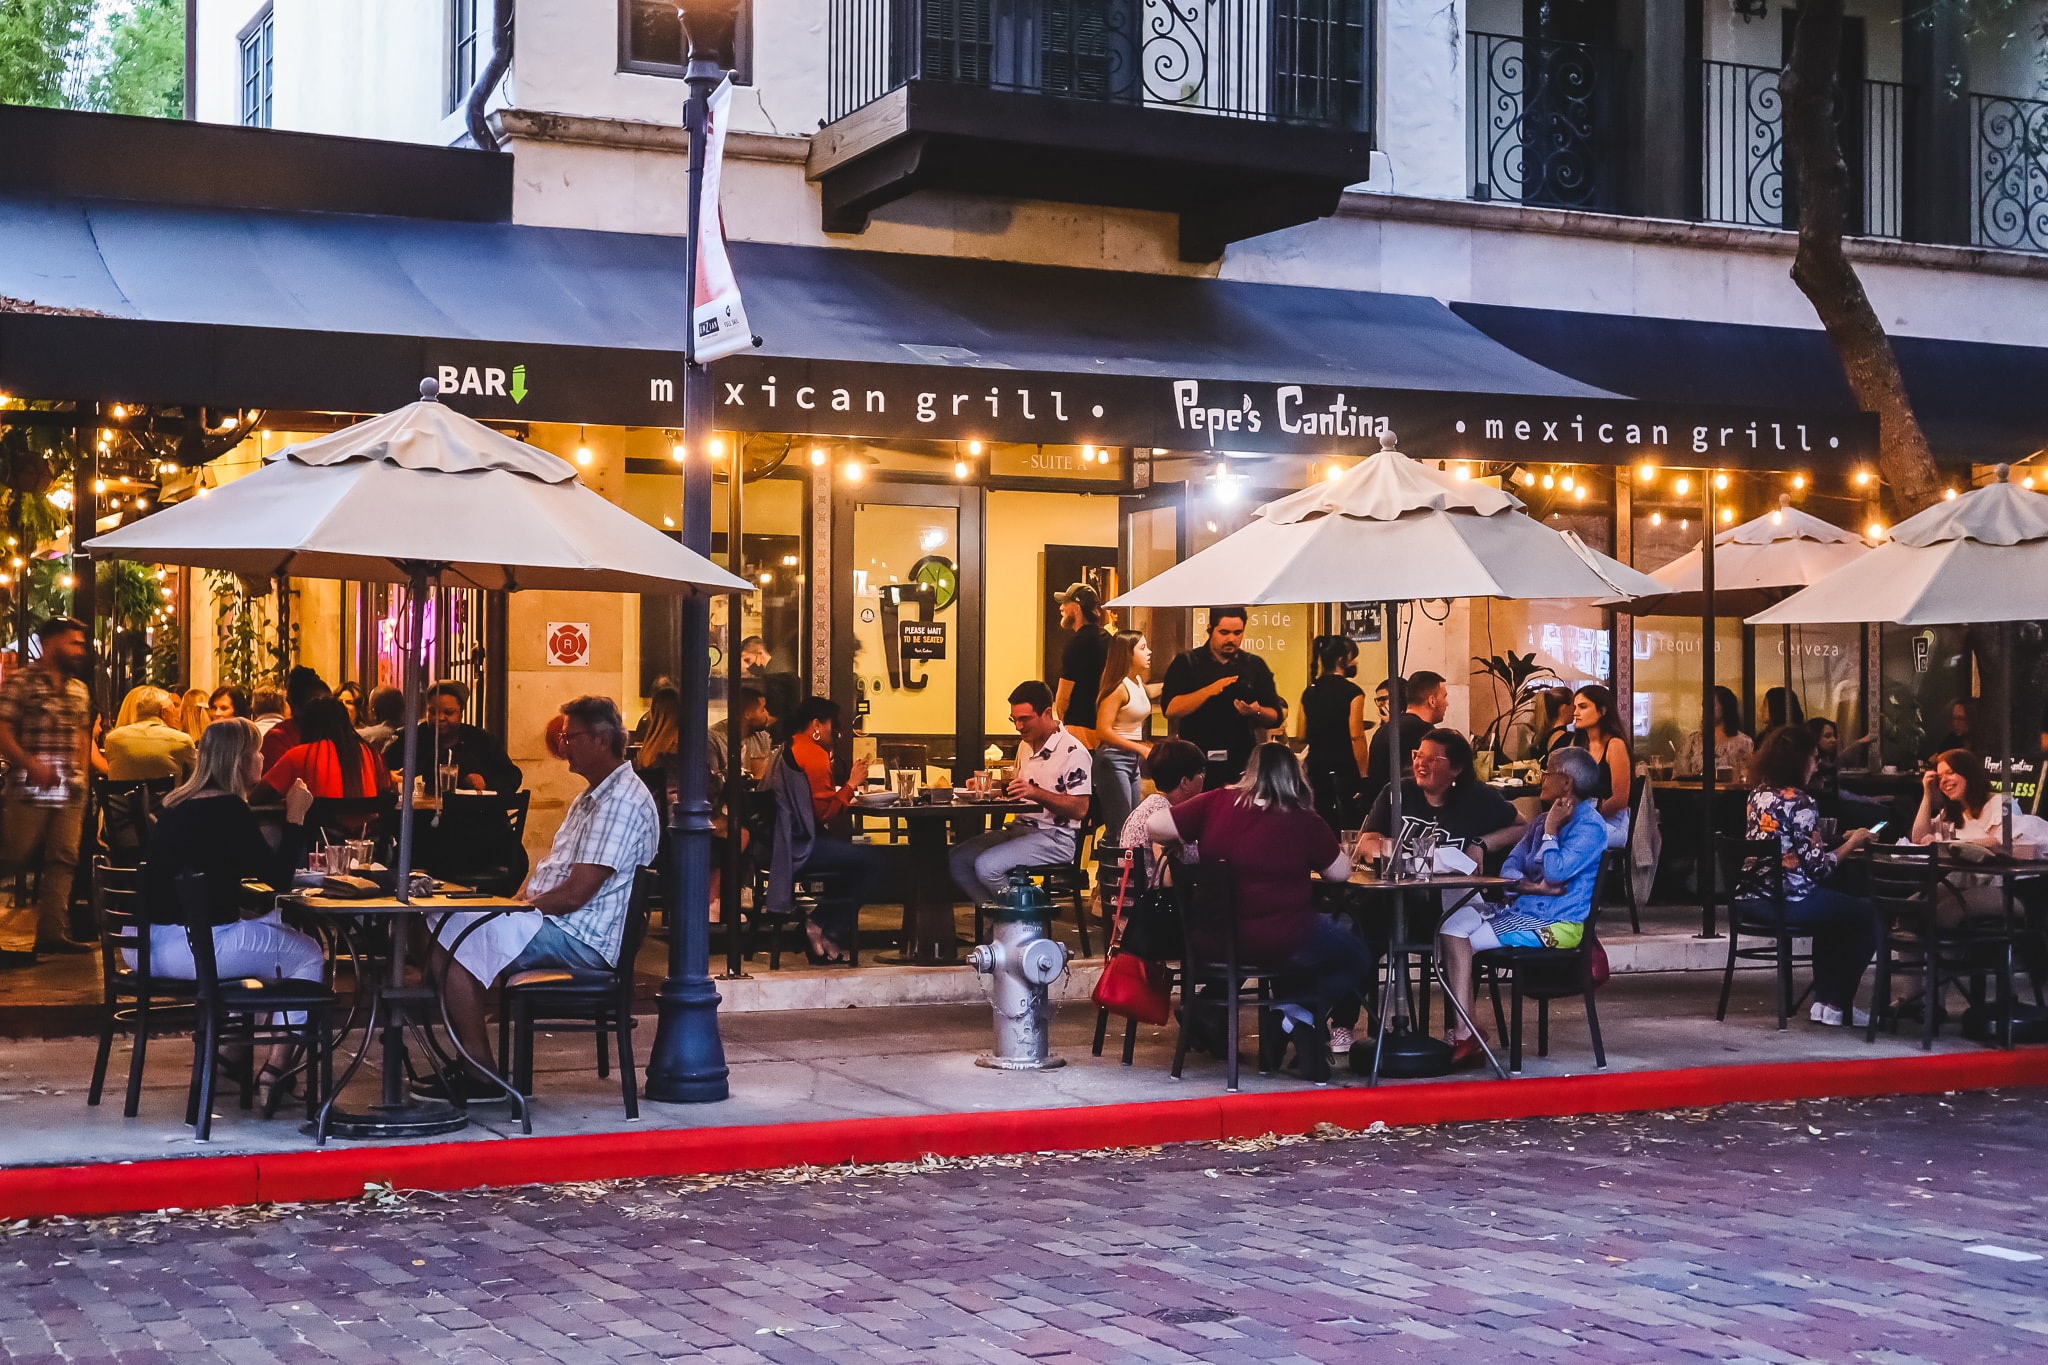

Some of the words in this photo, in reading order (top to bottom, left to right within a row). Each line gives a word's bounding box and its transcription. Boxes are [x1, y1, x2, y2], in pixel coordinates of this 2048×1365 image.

[437, 365, 507, 398] BAR
[649, 375, 885, 413] mxican
[916, 387, 1069, 422] grill
[1173, 379, 1262, 448] Pepe's
[1277, 386, 1390, 438] Cantina
[1485, 414, 1668, 446] mexican
[1692, 424, 1812, 453] grill
[1250, 611, 1292, 627] side
[904, 626, 926, 635] PLEASE
[927, 627, 942, 635] WAIT
[563, 639, 572, 649] R
[903, 635, 911, 643] TO
[913, 635, 921, 643] BE
[922, 635, 945, 644] SEATED
[1658, 637, 1721, 654] Tequia
